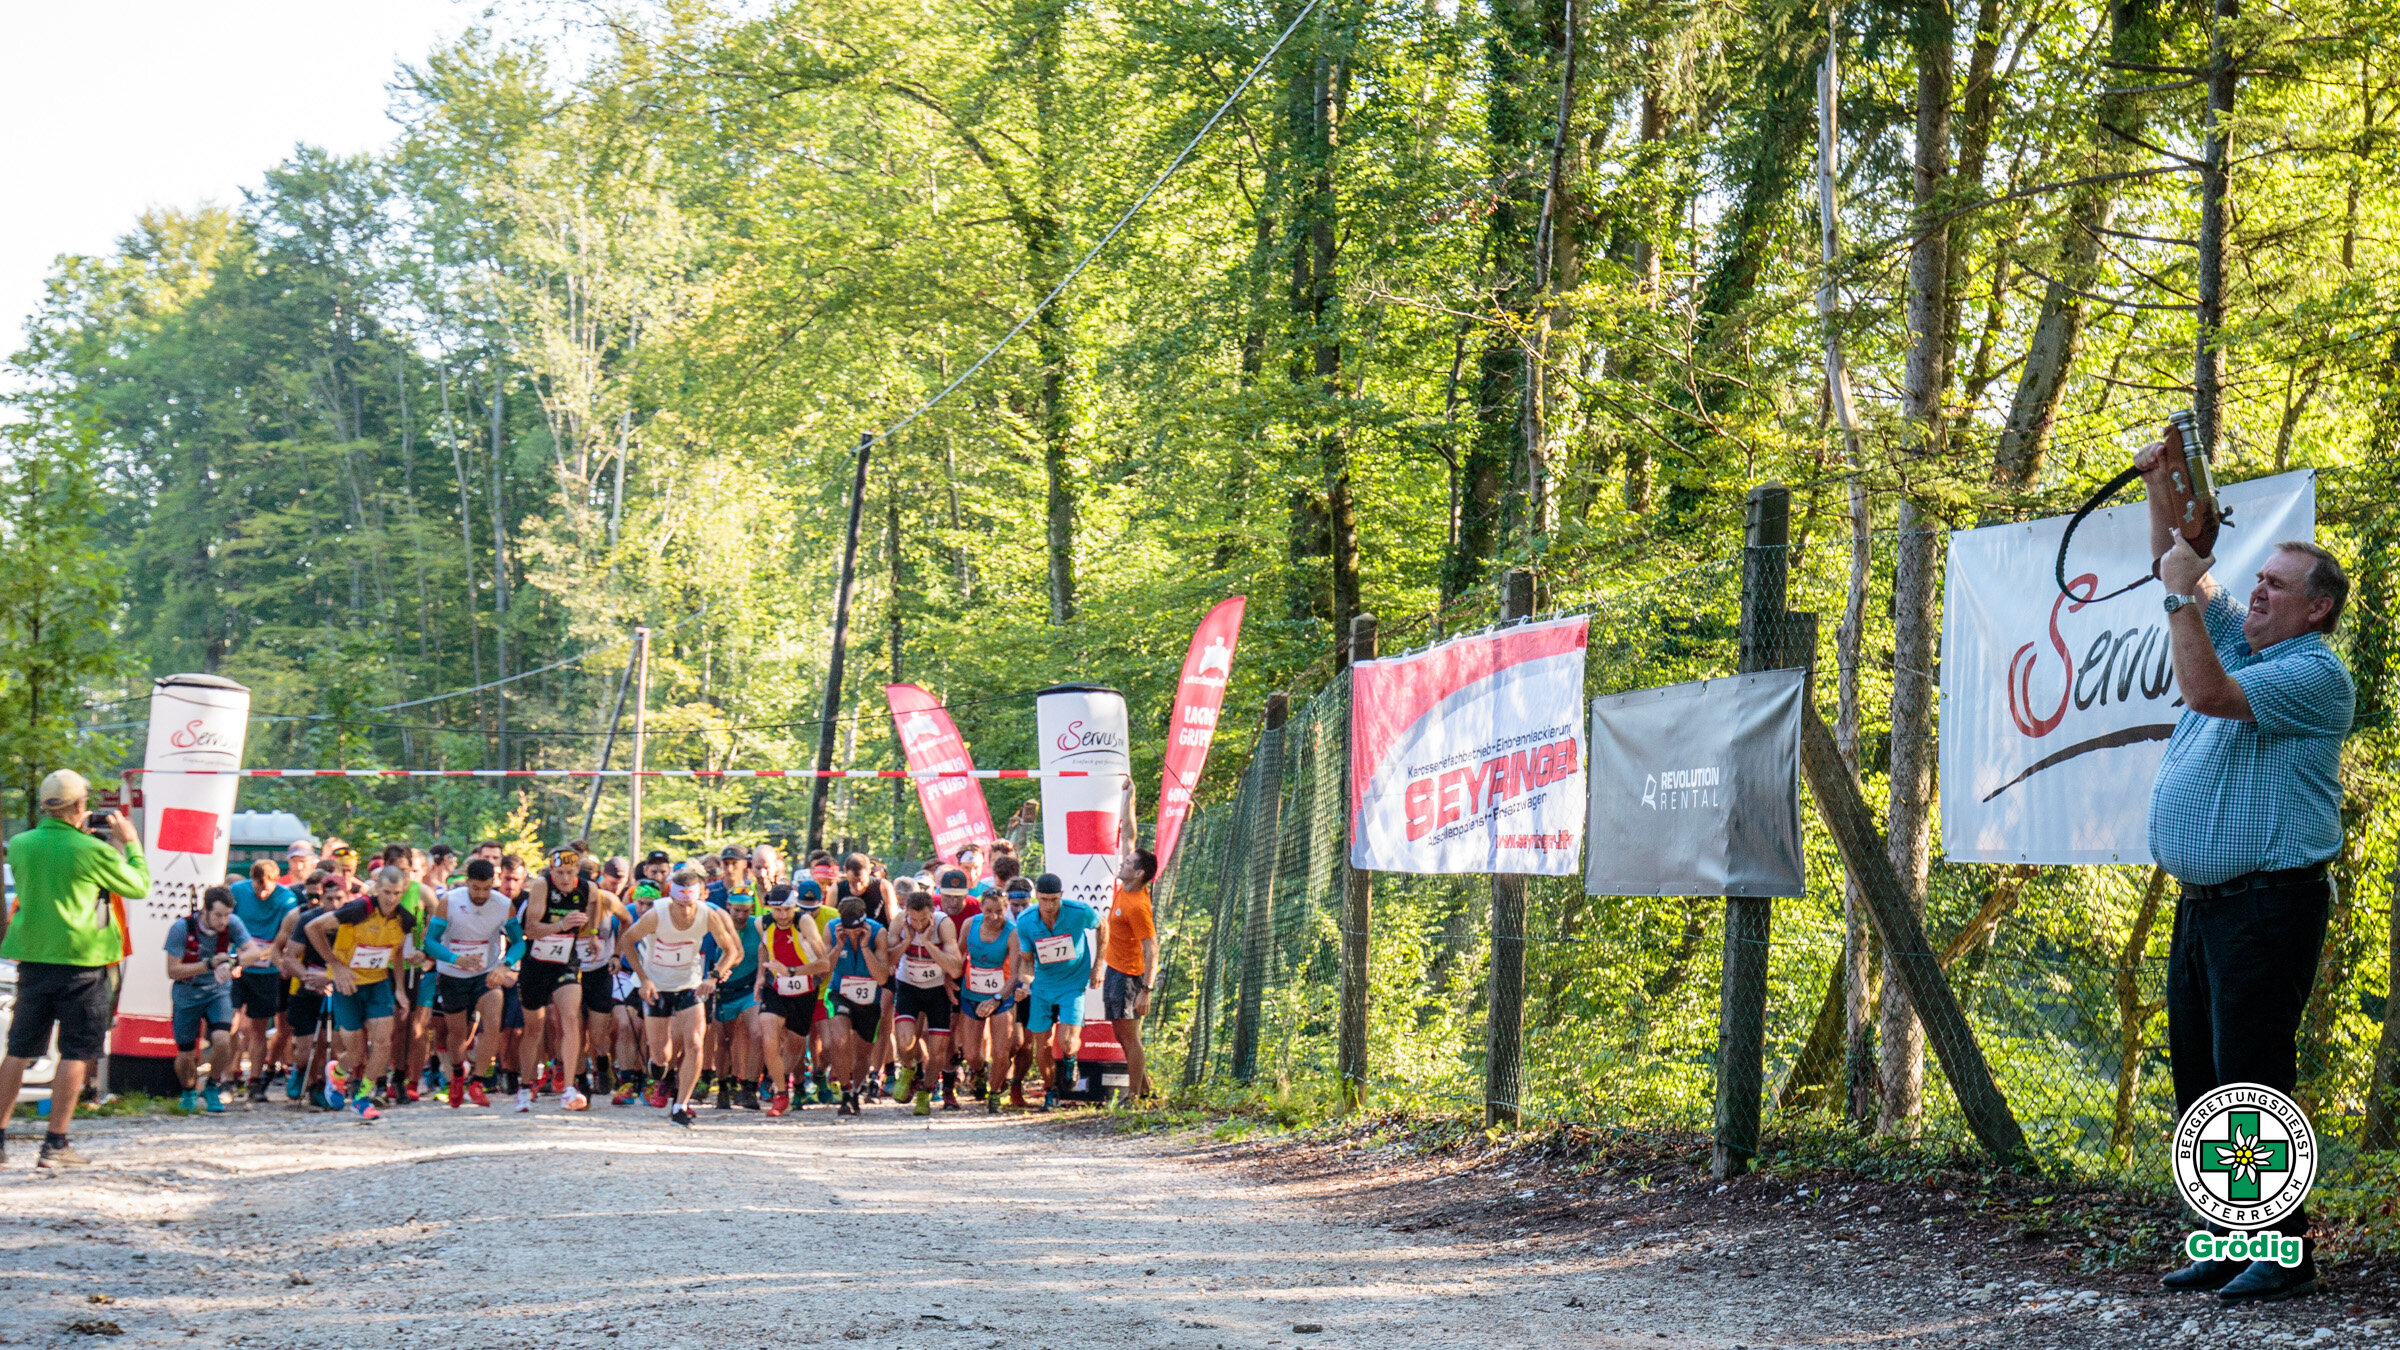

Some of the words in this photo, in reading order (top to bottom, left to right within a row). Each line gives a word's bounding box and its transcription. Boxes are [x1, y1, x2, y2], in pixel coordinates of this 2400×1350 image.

[2007, 573, 2185, 738] Servu
[1661, 767, 1719, 790] REVOLUTION
[1404, 737, 1577, 841] SEYRINGER
[1660, 788, 1719, 810] RENTAL
[550, 945, 563, 956] 74
[1054, 946, 1067, 957] 77
[922, 969, 936, 979] 48
[787, 979, 801, 990] 40
[984, 978, 998, 989] 46
[855, 987, 869, 999] 93
